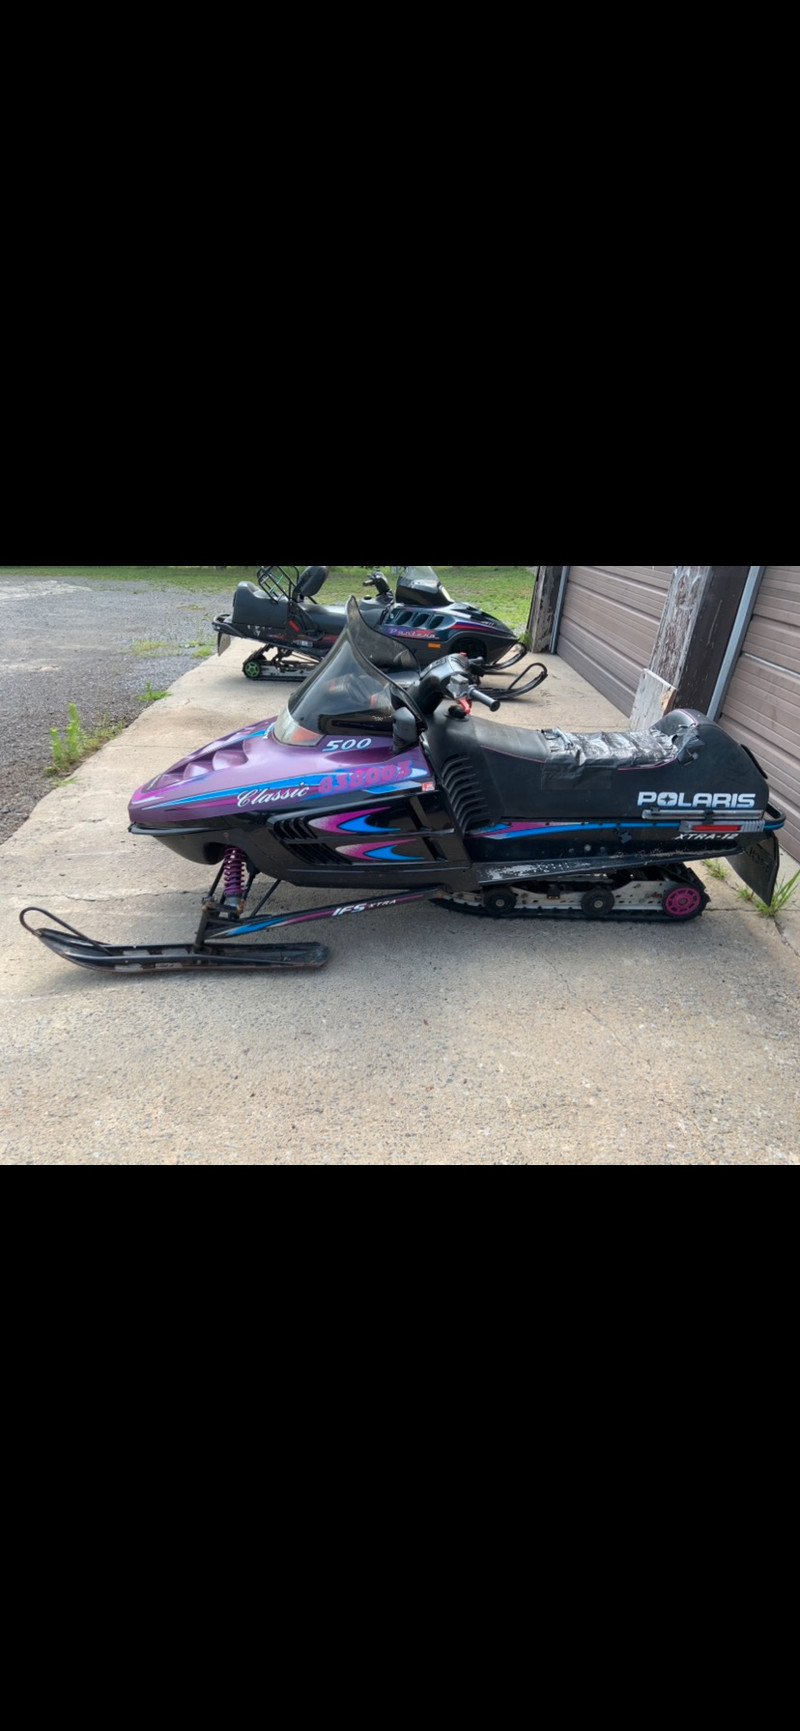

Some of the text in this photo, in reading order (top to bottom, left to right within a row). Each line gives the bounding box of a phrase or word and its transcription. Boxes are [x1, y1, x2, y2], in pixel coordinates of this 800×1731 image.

[321, 738, 372, 752] 500
[236, 781, 310, 807] Classic
[636, 791, 756, 808] POLARIS
[331, 899, 396, 917] IFS XTRA
